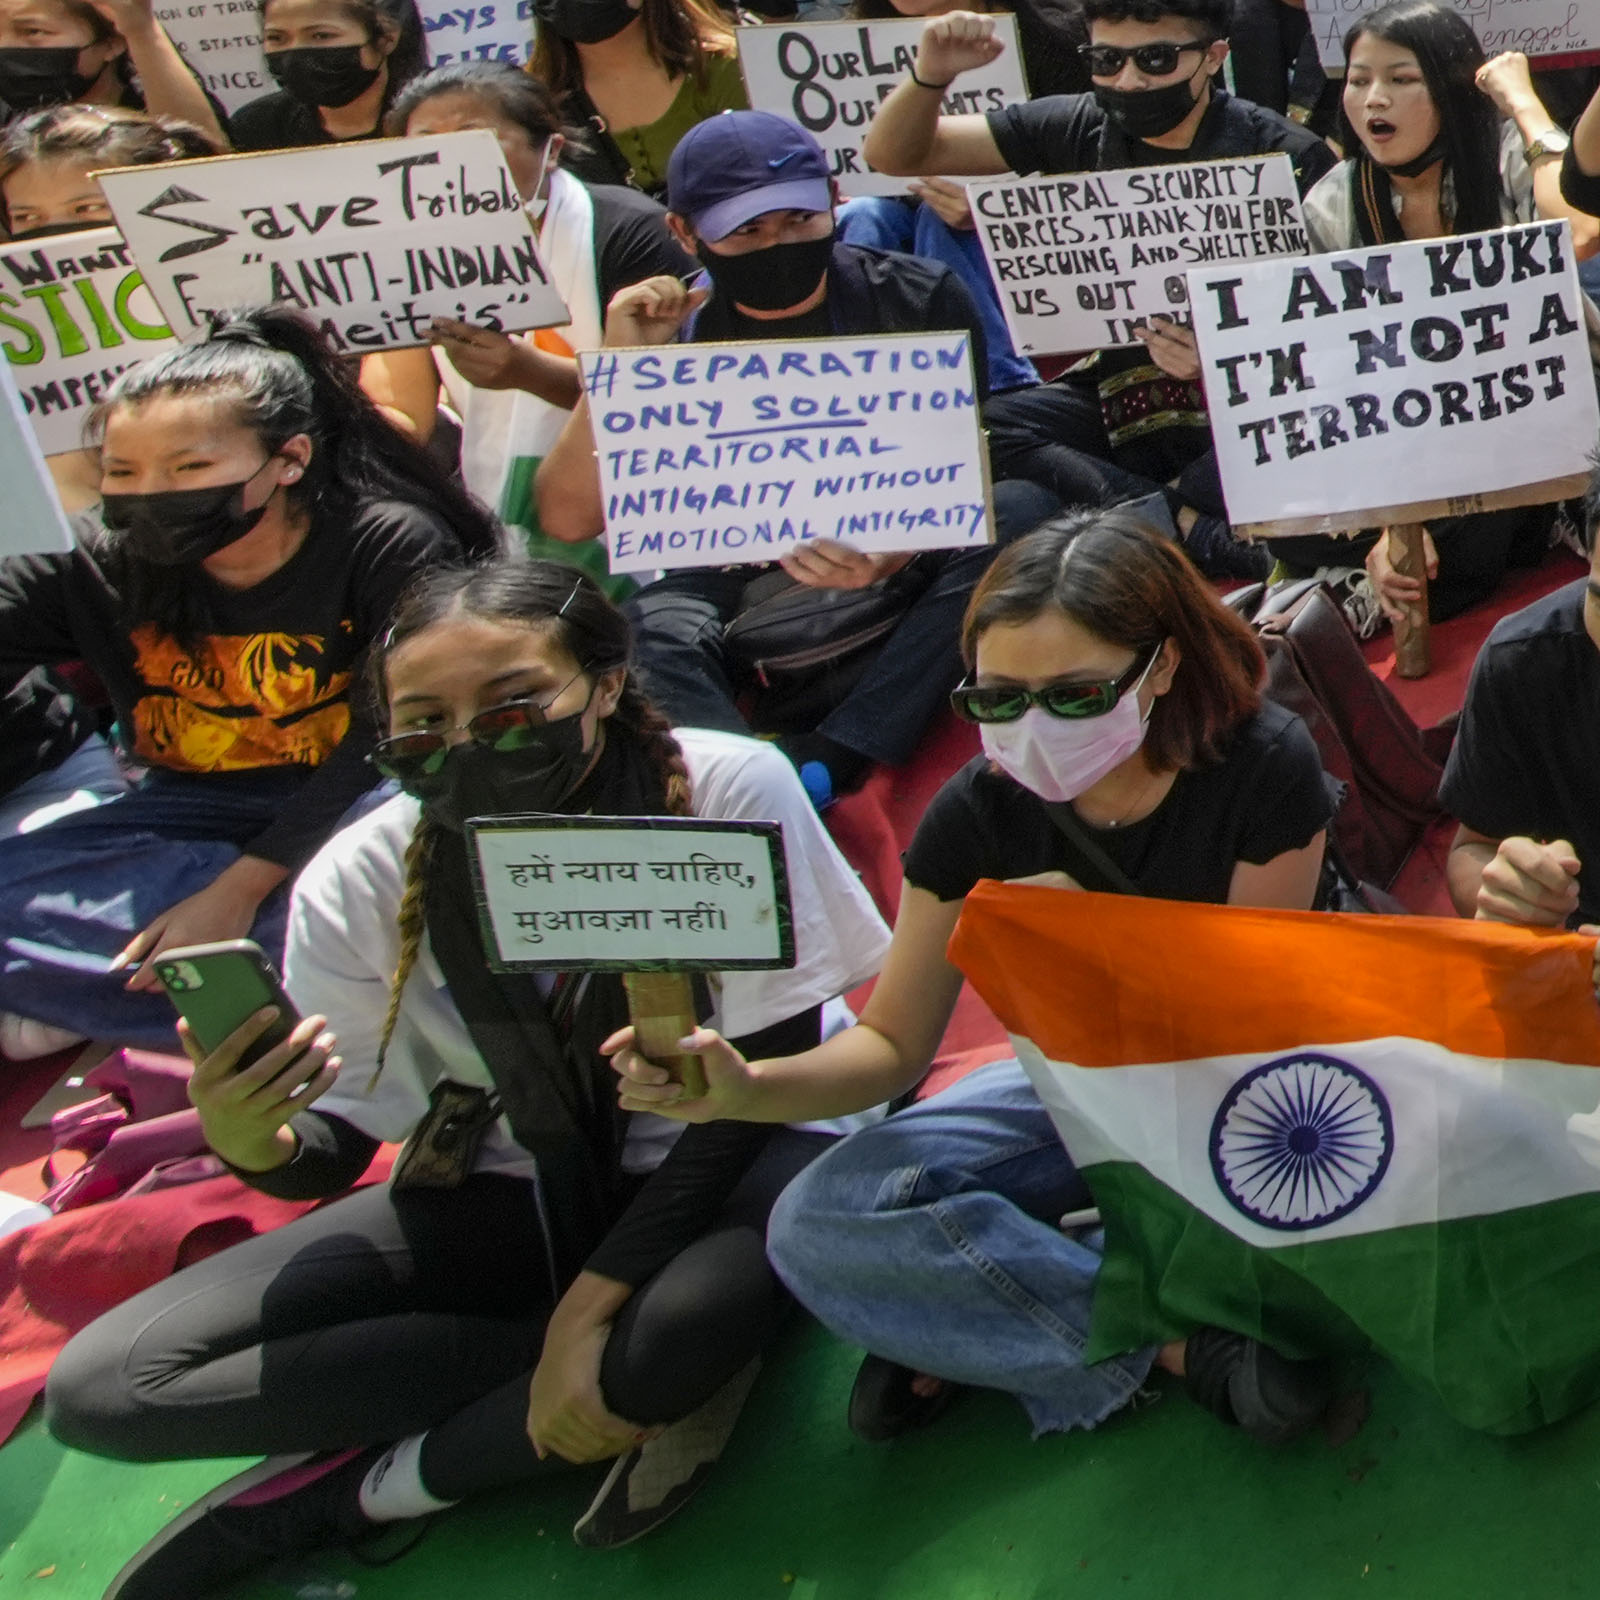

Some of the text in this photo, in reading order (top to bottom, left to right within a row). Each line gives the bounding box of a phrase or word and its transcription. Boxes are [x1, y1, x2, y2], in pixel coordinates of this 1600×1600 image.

[1206, 223, 1564, 331] I AM KUKI
[1216, 293, 1577, 407] I'M NOT A
[1239, 356, 1566, 466] TERRORIST
[506, 854, 555, 887] हमें
[563, 862, 639, 882] न्याय
